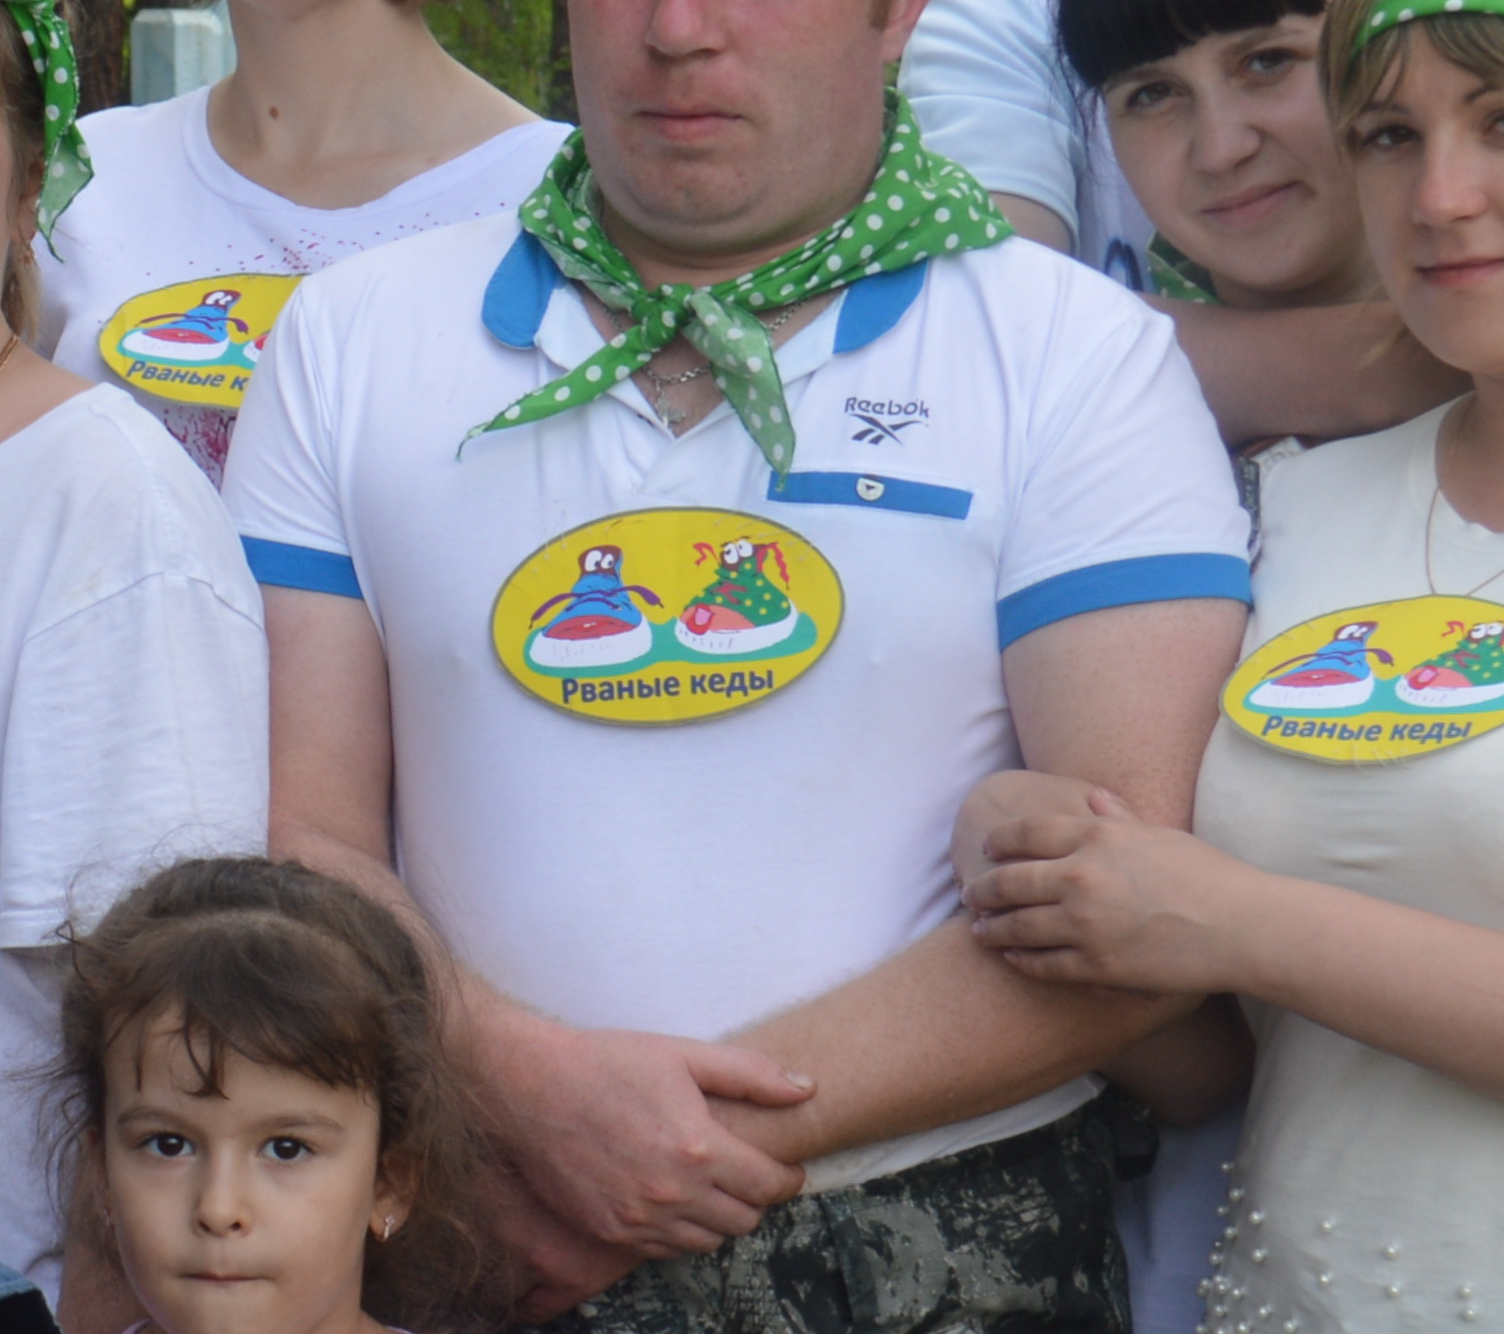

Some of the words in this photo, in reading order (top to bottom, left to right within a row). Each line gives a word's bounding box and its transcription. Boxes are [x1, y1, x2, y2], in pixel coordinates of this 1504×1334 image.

[126, 360, 225, 388] Рваные
[844, 397, 929, 418] Reebok
[561, 672, 680, 703] Рваные
[690, 669, 774, 698] кеды
[1260, 715, 1382, 741] Рваные
[1389, 720, 1472, 746] кеды
